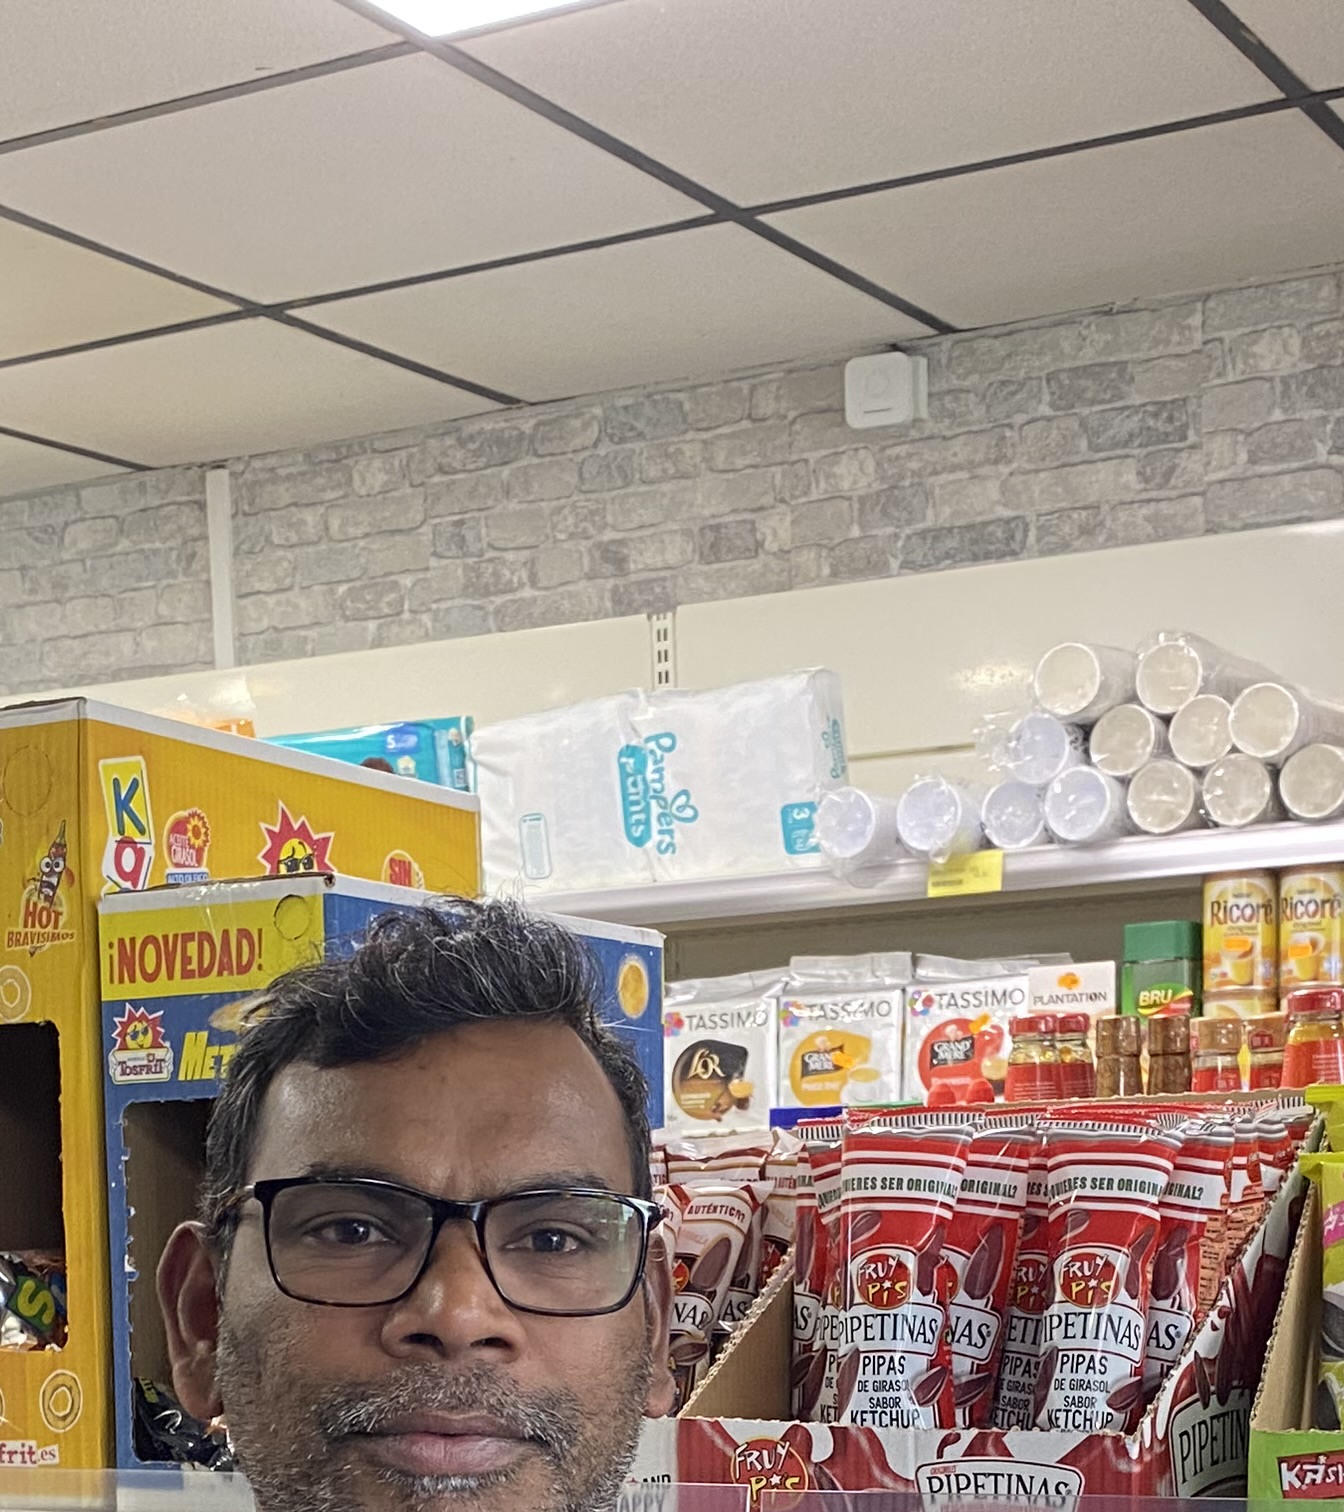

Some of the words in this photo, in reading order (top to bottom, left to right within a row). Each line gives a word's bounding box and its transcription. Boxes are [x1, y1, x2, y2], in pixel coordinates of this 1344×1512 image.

[24, 902, 63, 929] HOT
[108, 928, 264, 985] ¡NOVEDAD!
[935, 989, 1025, 1010] TASSIMO
[1034, 989, 1107, 1006] PLANTATION
[685, 1010, 768, 1031] TASSIMO
[118, 1059, 164, 1077] TOSFRIT
[1090, 1177, 1113, 1191] SER
[1060, 1353, 1108, 1375] PIPAS
[1069, 1379, 1110, 1393] GIRASOL
[1063, 1396, 1097, 1408] SABOR
[1047, 1409, 1114, 1429] KETCHUP
[734, 1443, 791, 1482] FRUY
